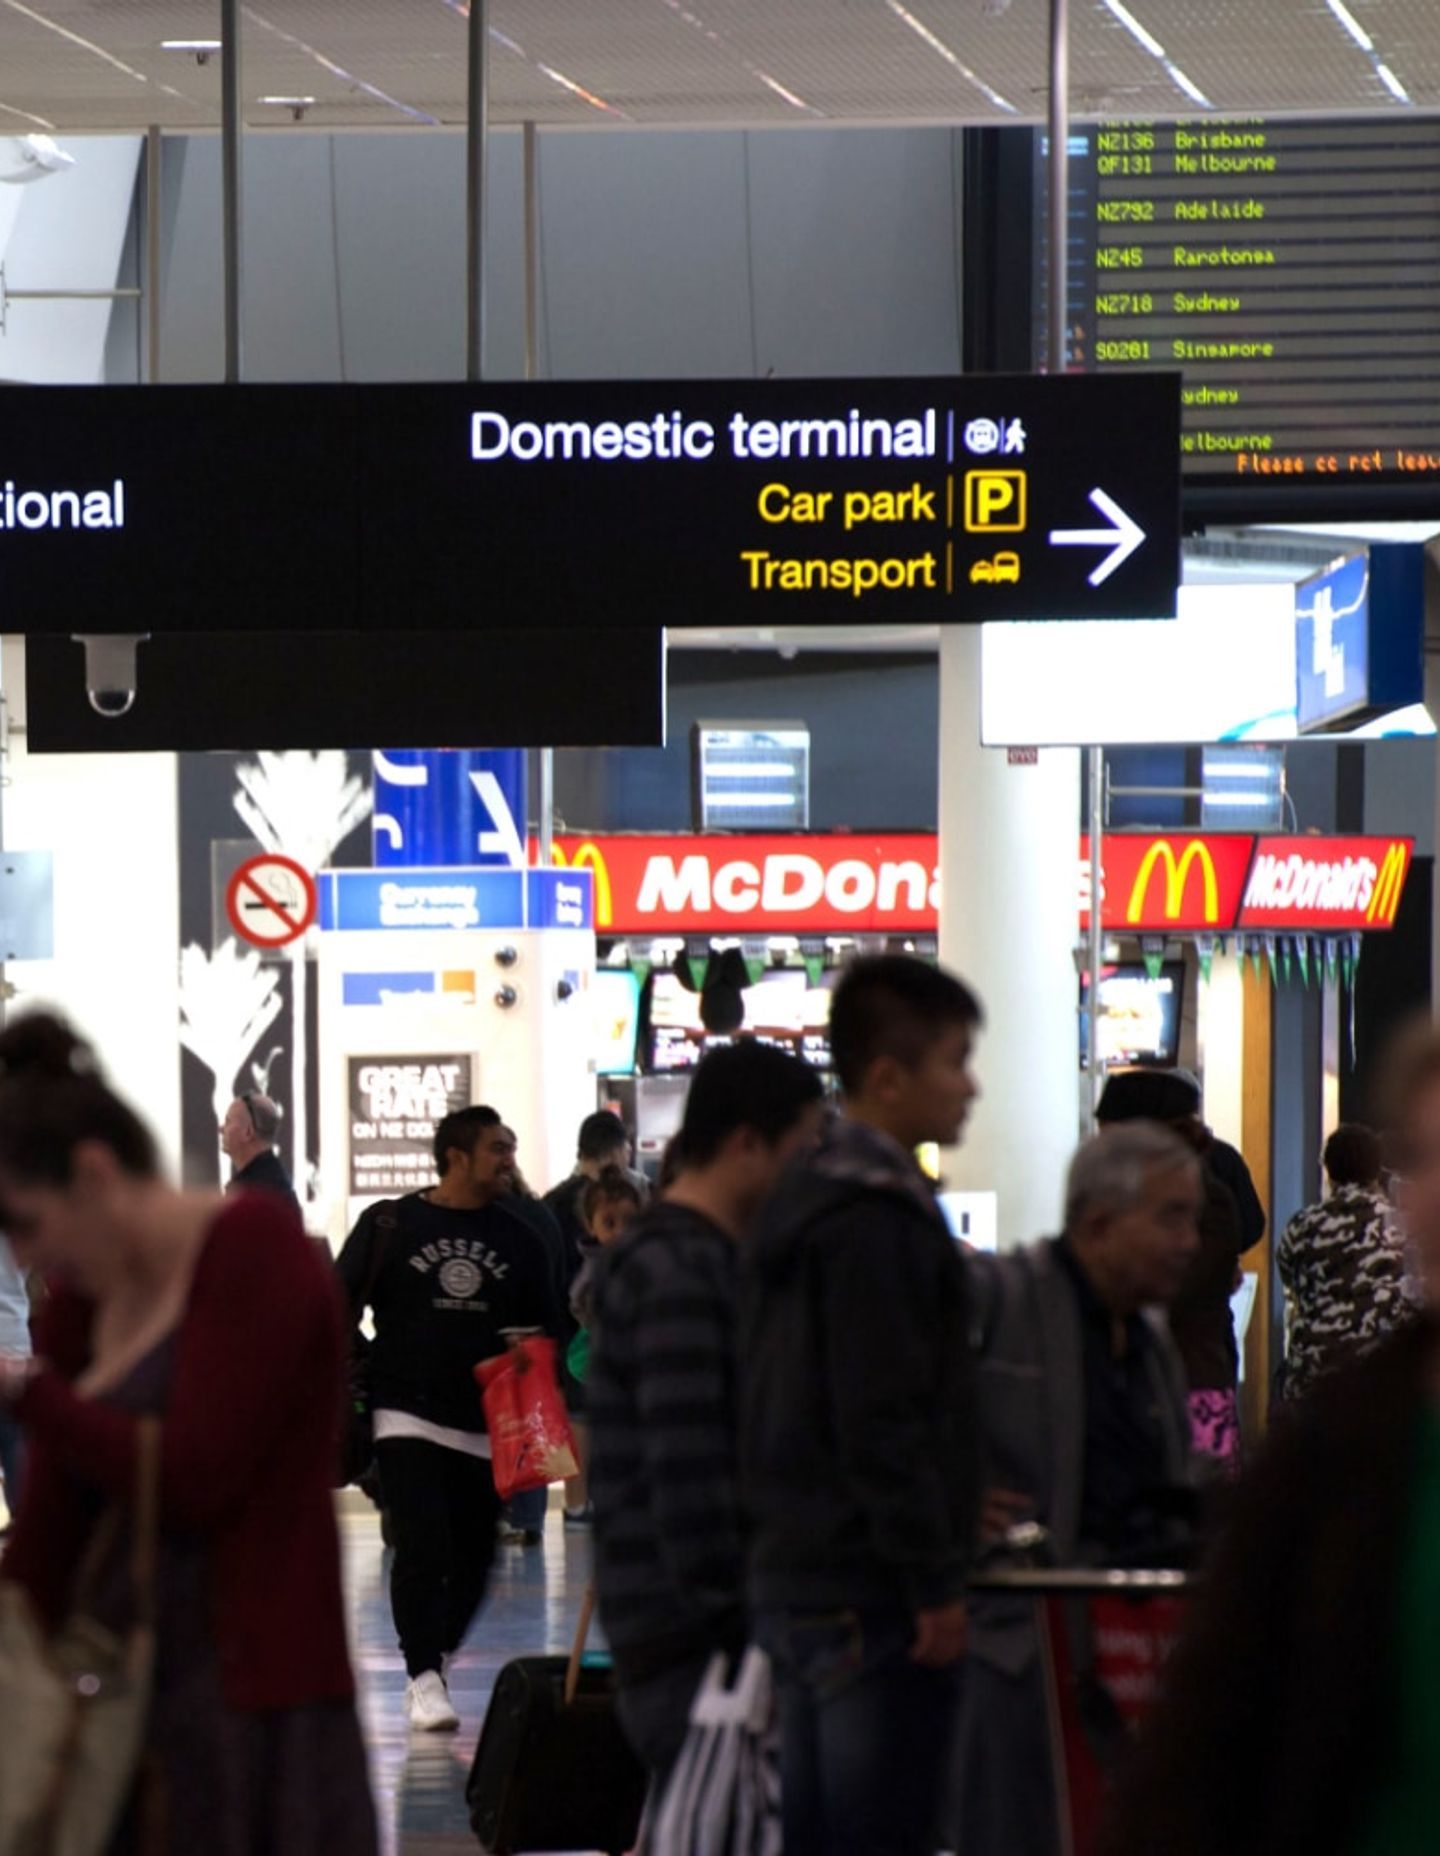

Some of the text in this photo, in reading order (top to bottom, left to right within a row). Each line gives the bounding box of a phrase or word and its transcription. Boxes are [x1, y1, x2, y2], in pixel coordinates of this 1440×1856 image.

[1097, 131, 1266, 151] NZ136 Brisbane
[1174, 154, 1277, 172] Melbourne
[1096, 200, 1265, 222] NZ792 Adelaide
[1095, 291, 1241, 315] NZ718 Sydney
[1173, 340, 1274, 359] Singapore
[1182, 387, 1239, 405] ydney
[471, 408, 936, 461] Domestic terminal
[1180, 433, 1273, 452] elbourne
[758, 483, 834, 523] Car
[844, 483, 935, 530] park
[740, 551, 936, 597] Transport
[409, 1238, 511, 1280] RUSSELL
